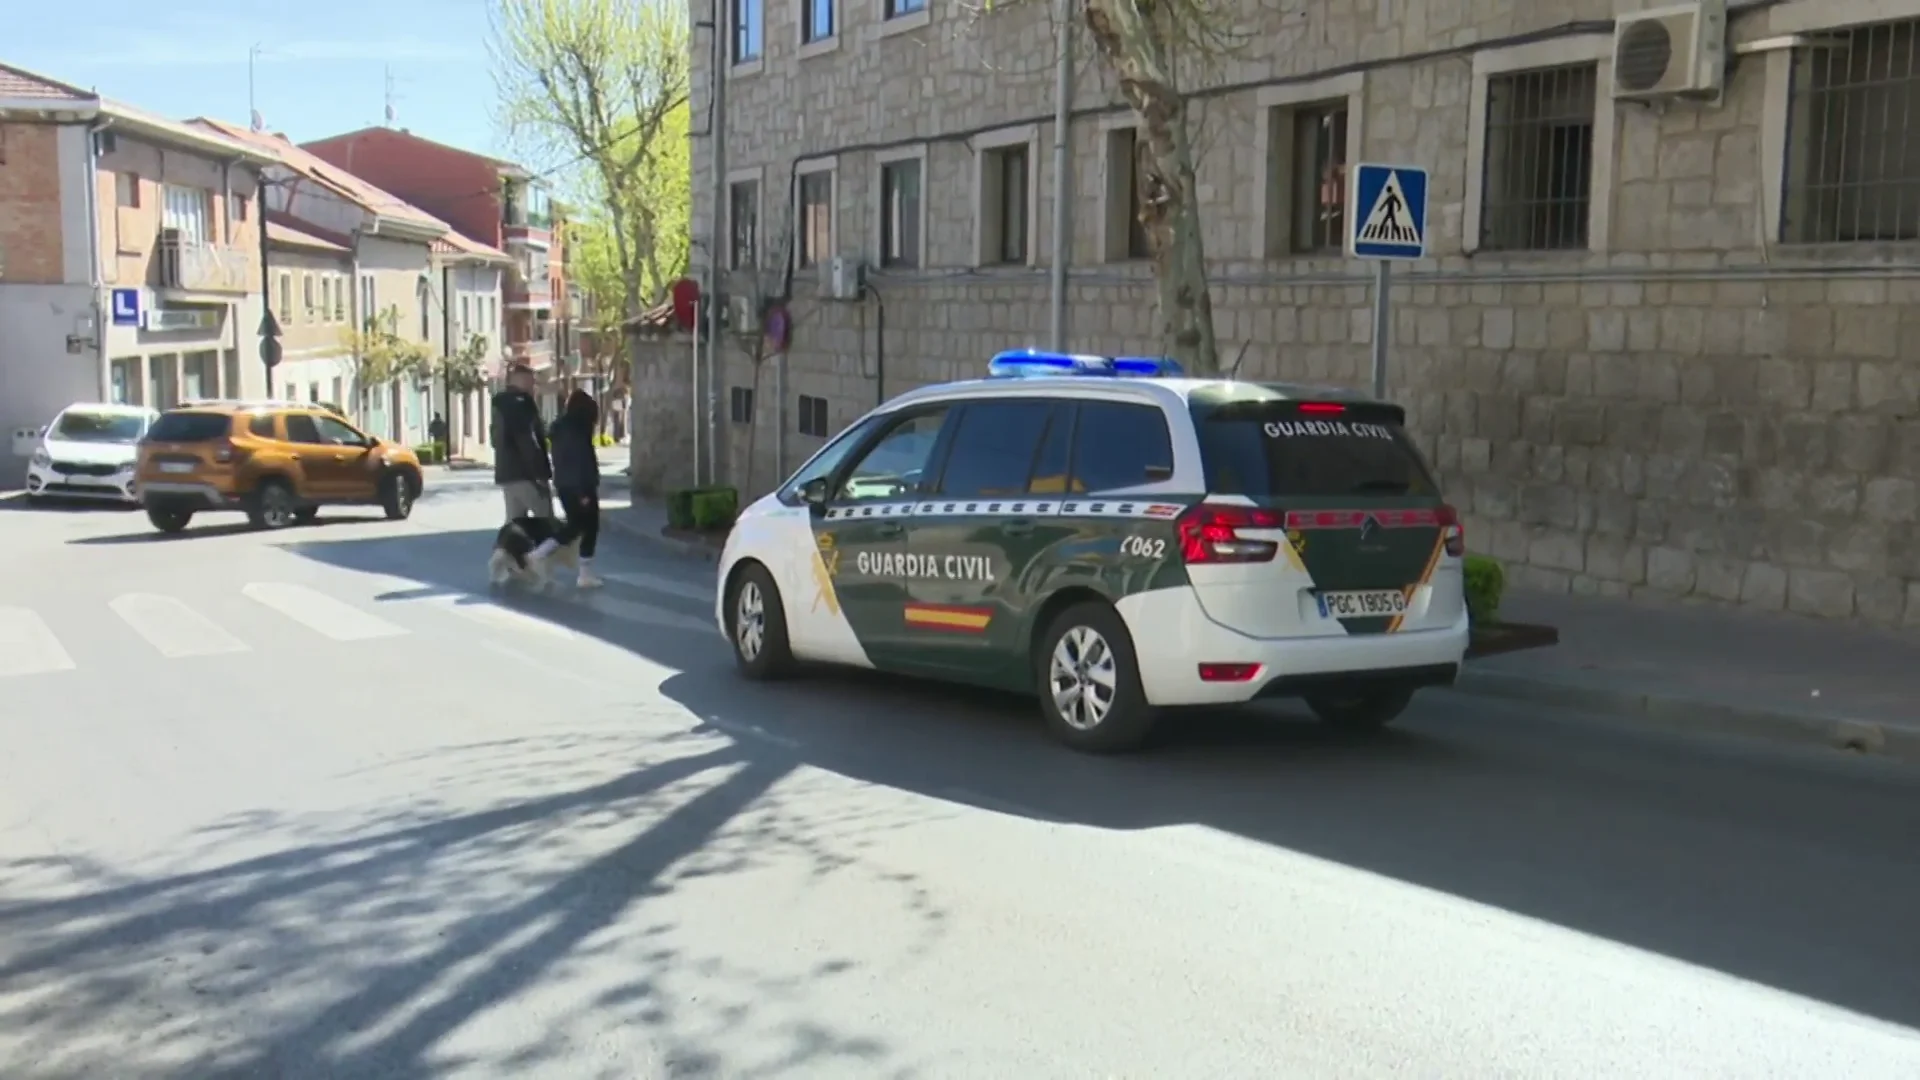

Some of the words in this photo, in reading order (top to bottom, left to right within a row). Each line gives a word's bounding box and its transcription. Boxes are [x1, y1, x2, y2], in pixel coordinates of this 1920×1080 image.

[116, 292, 136, 316] L
[1263, 420, 1351, 438] GUARDIA
[1351, 422, 1393, 442] CIVIL
[857, 550, 939, 577] GUARDIA
[944, 555, 995, 581] CIVIL
[1326, 594, 1356, 615] PGC
[1358, 593, 1393, 612] 1905
